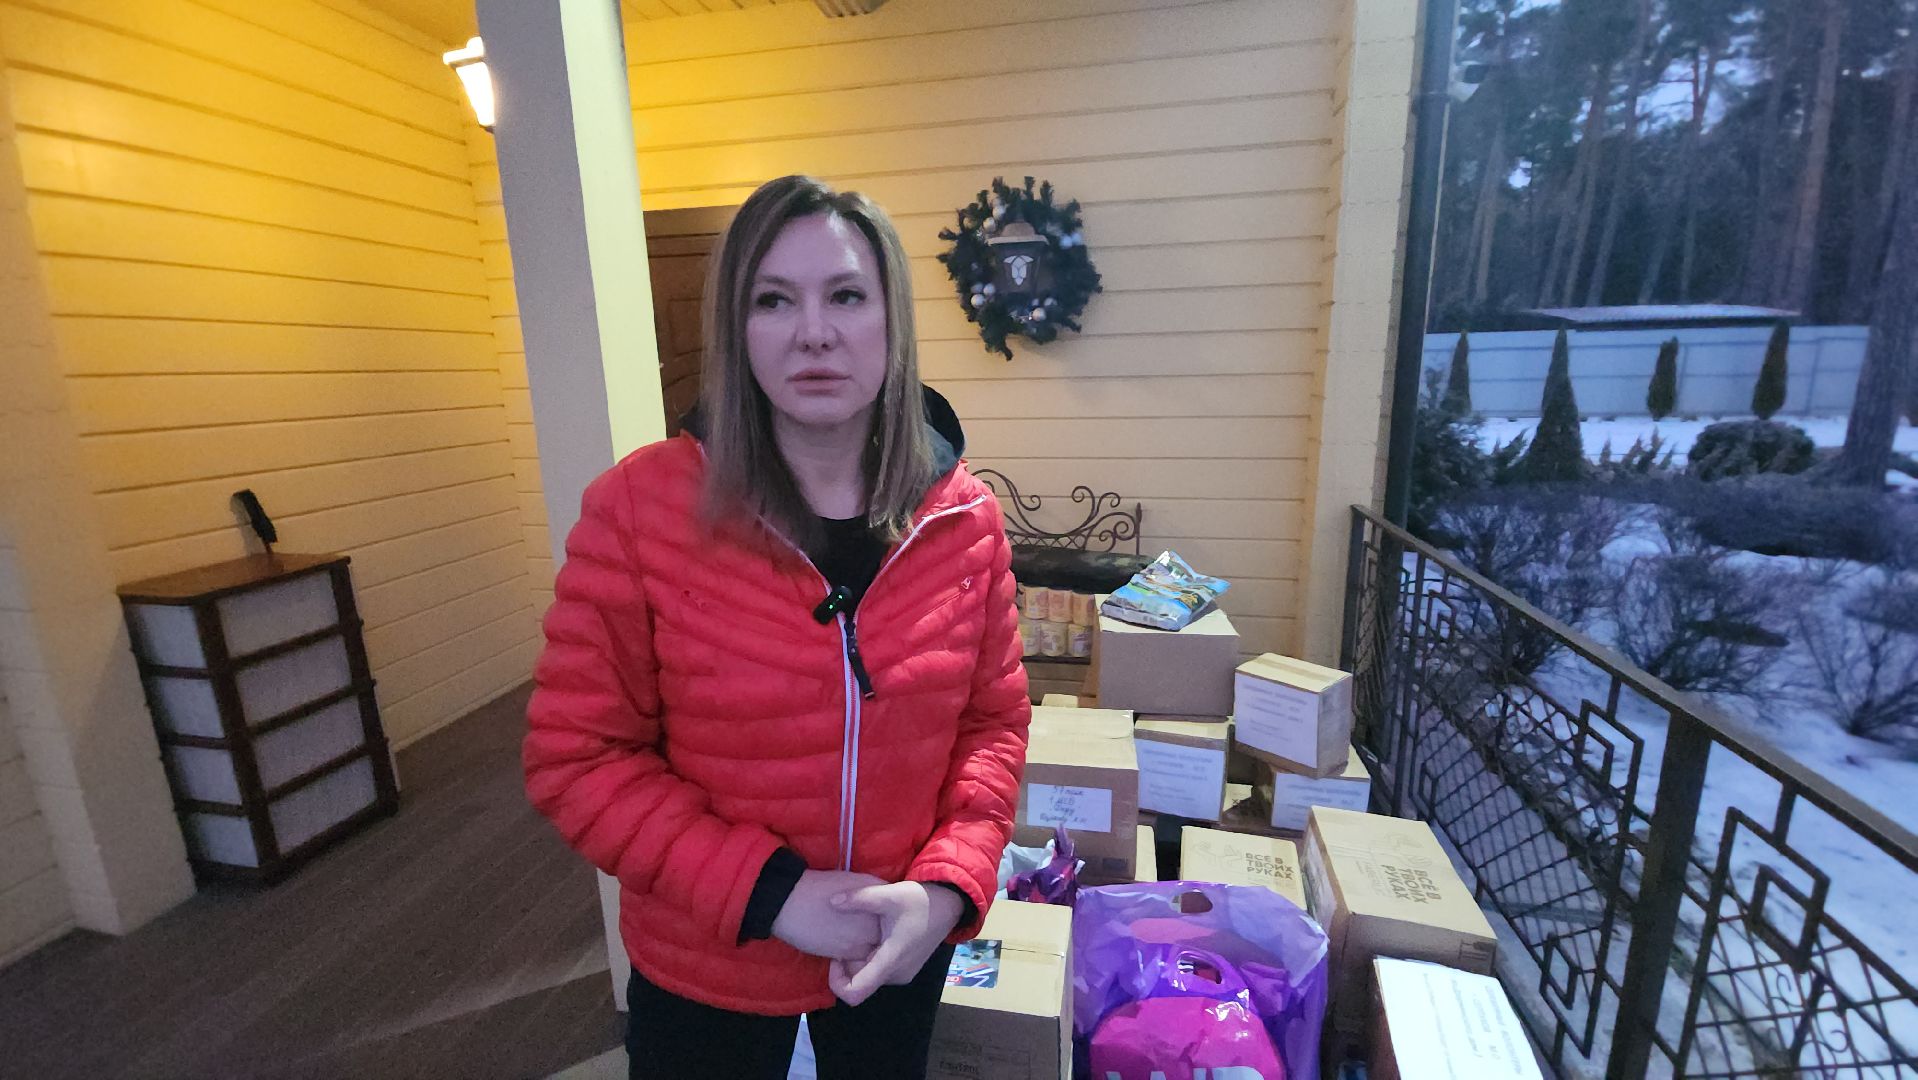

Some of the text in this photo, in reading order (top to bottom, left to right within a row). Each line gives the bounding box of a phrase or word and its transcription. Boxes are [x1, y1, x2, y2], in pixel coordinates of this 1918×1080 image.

[1246, 853, 1272, 863] ВСЕ
[1246, 859, 1295, 874] ТВОИХ
[1247, 866, 1294, 880] РУКАХ
[1381, 864, 1412, 901] РУКАХ
[1414, 869, 1440, 892] ВСЕ
[1399, 868, 1430, 904] ТВОИХ
